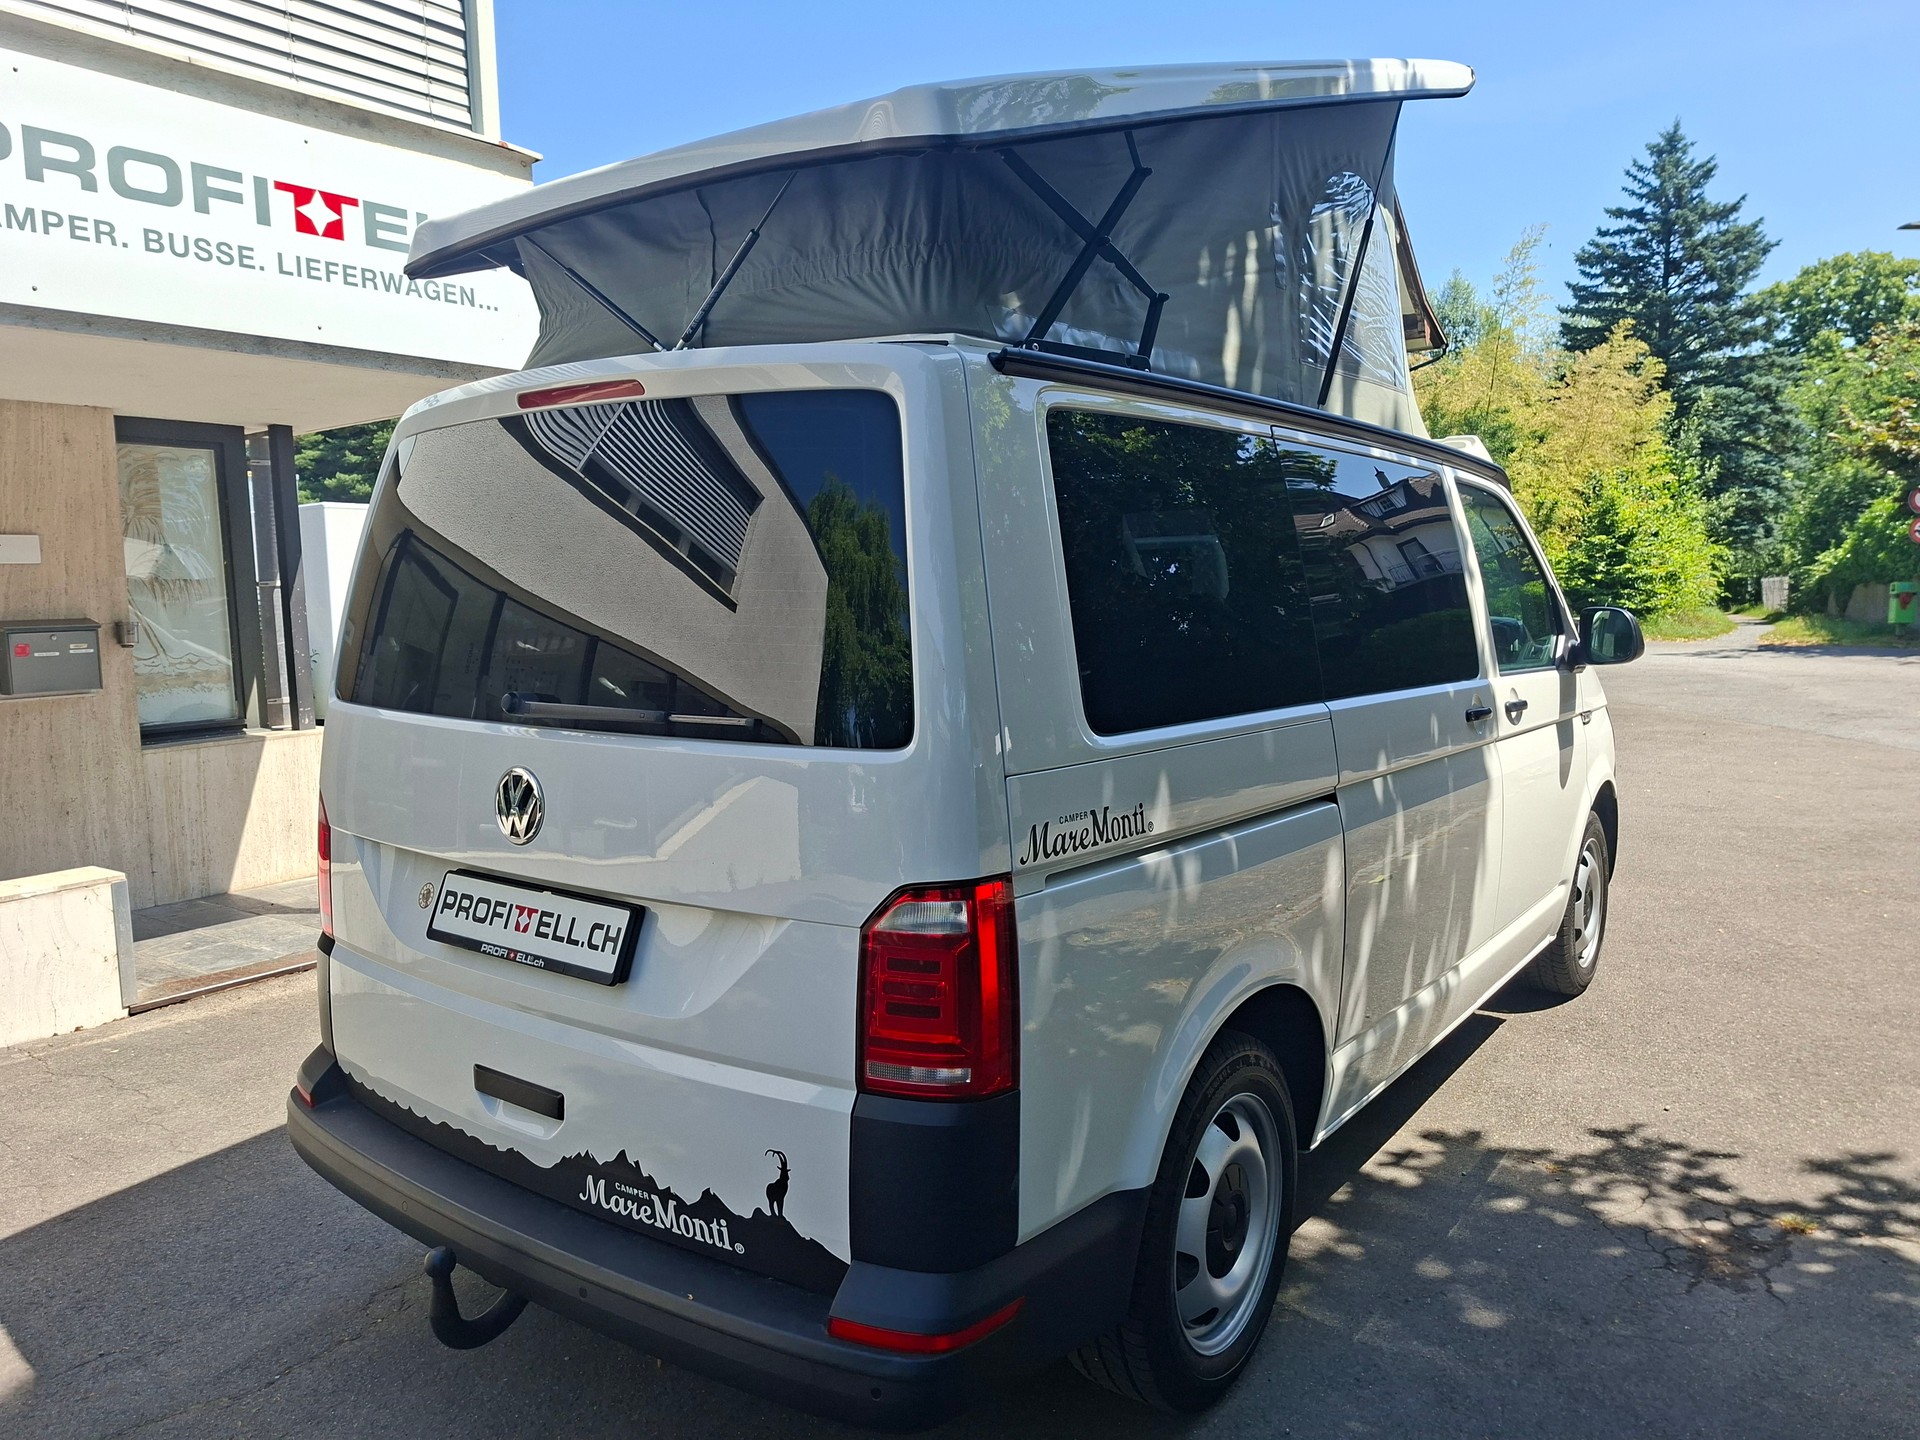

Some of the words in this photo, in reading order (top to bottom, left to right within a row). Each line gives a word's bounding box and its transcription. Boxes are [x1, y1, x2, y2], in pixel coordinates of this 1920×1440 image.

[0, 121, 430, 255] ROFITE
[0, 203, 128, 248] MPER.
[143, 227, 265, 272] BUSSE.
[1059, 811, 1088, 825] CAMPER
[440, 889, 622, 955] PROFITELL.CH
[615, 1181, 650, 1200] CAMPER
